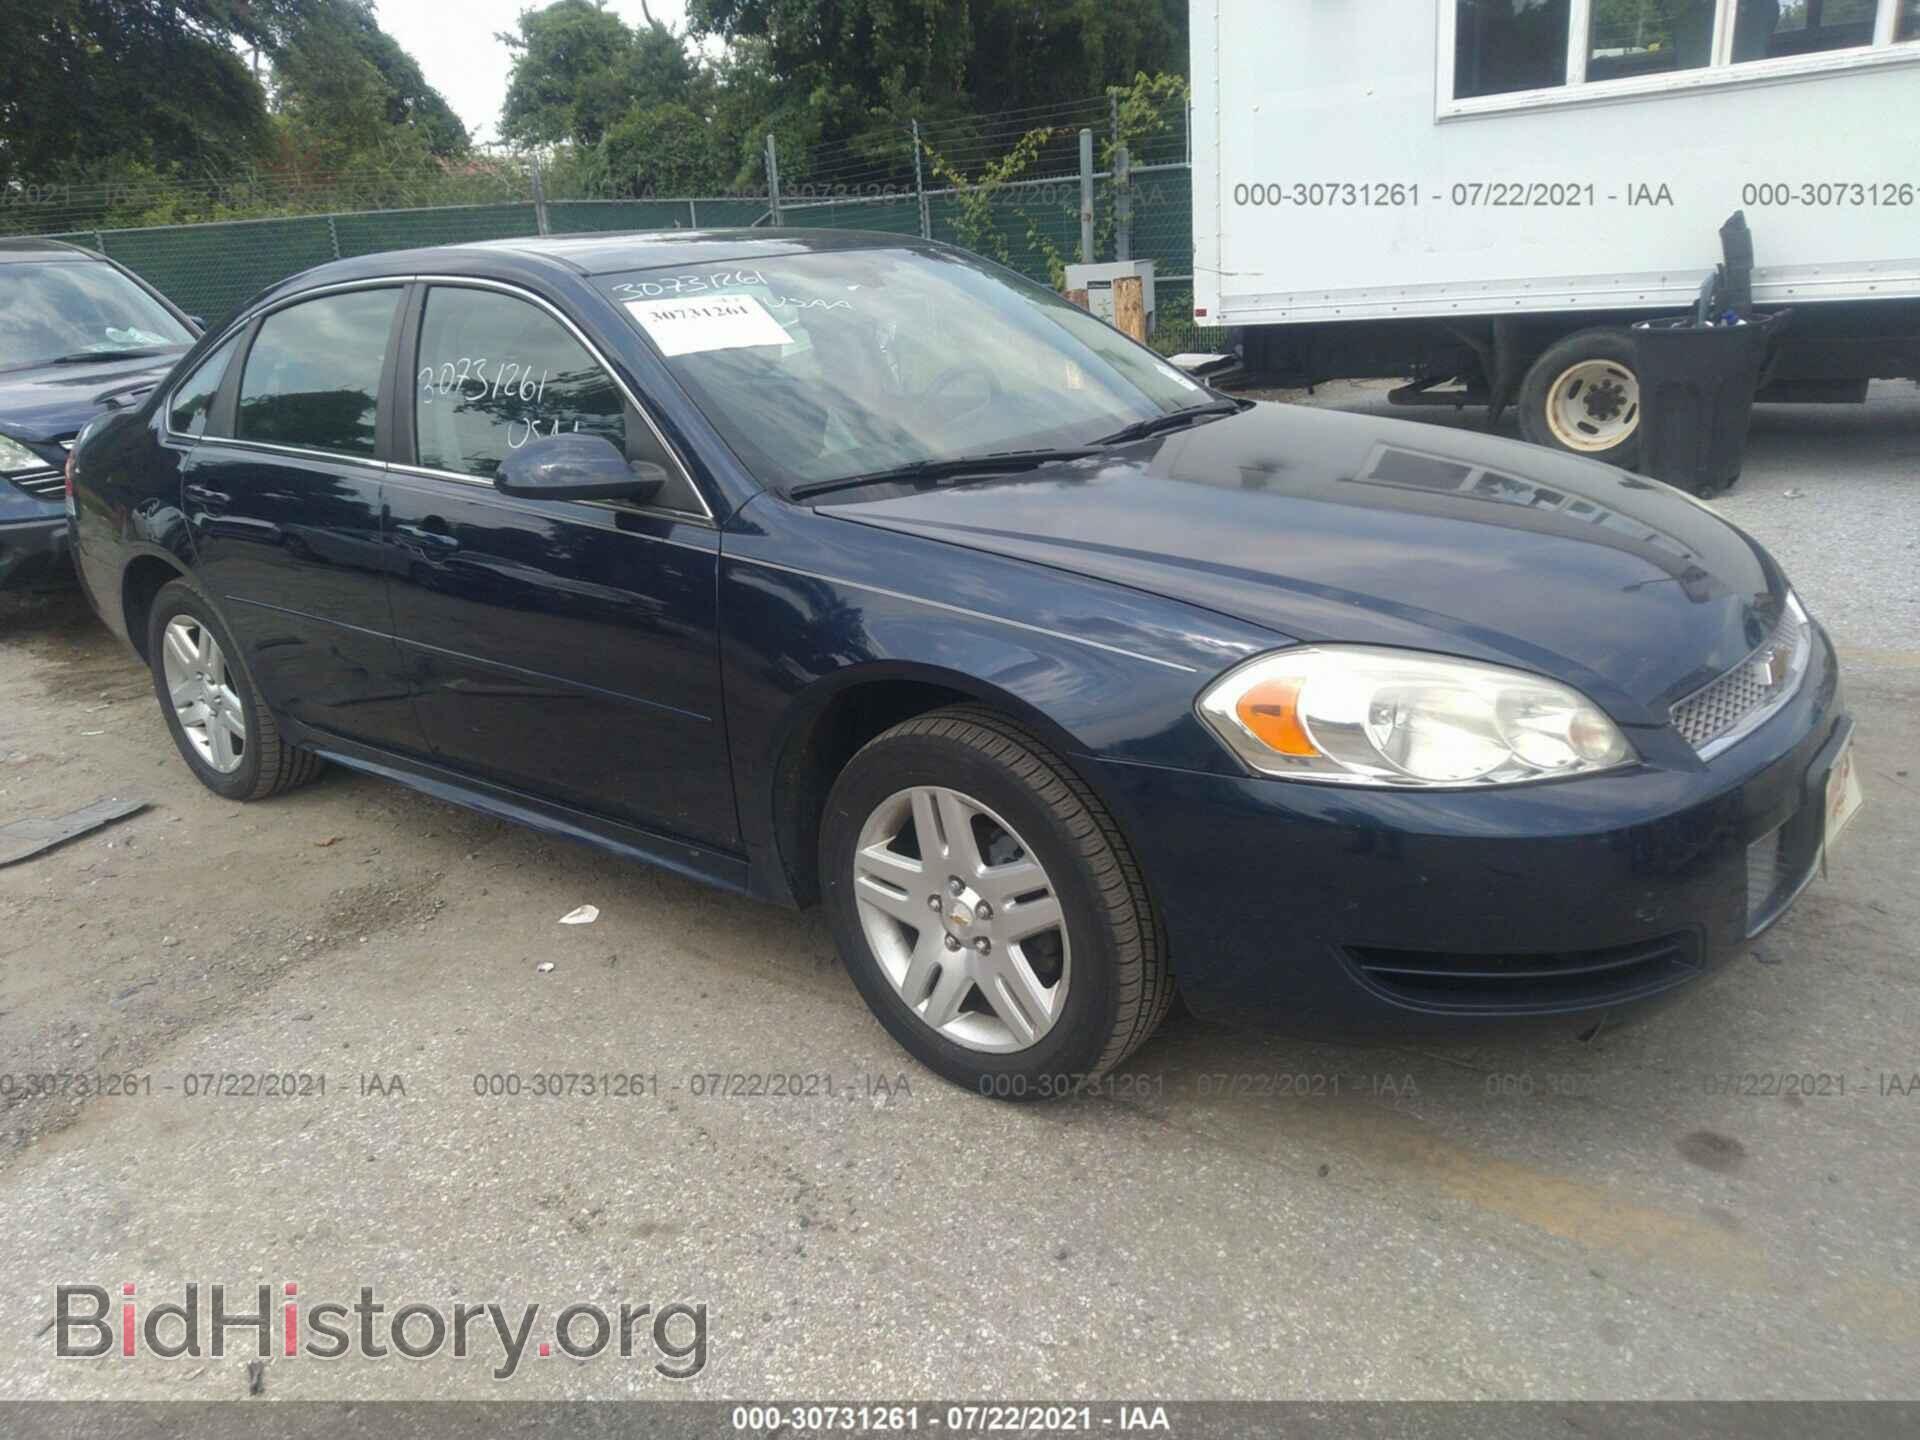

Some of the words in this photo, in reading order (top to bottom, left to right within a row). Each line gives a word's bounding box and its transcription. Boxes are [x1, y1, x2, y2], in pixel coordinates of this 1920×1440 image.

[612, 271, 768, 301] 30731261
[651, 304, 750, 323] 30731261
[418, 358, 548, 404] 30731261
